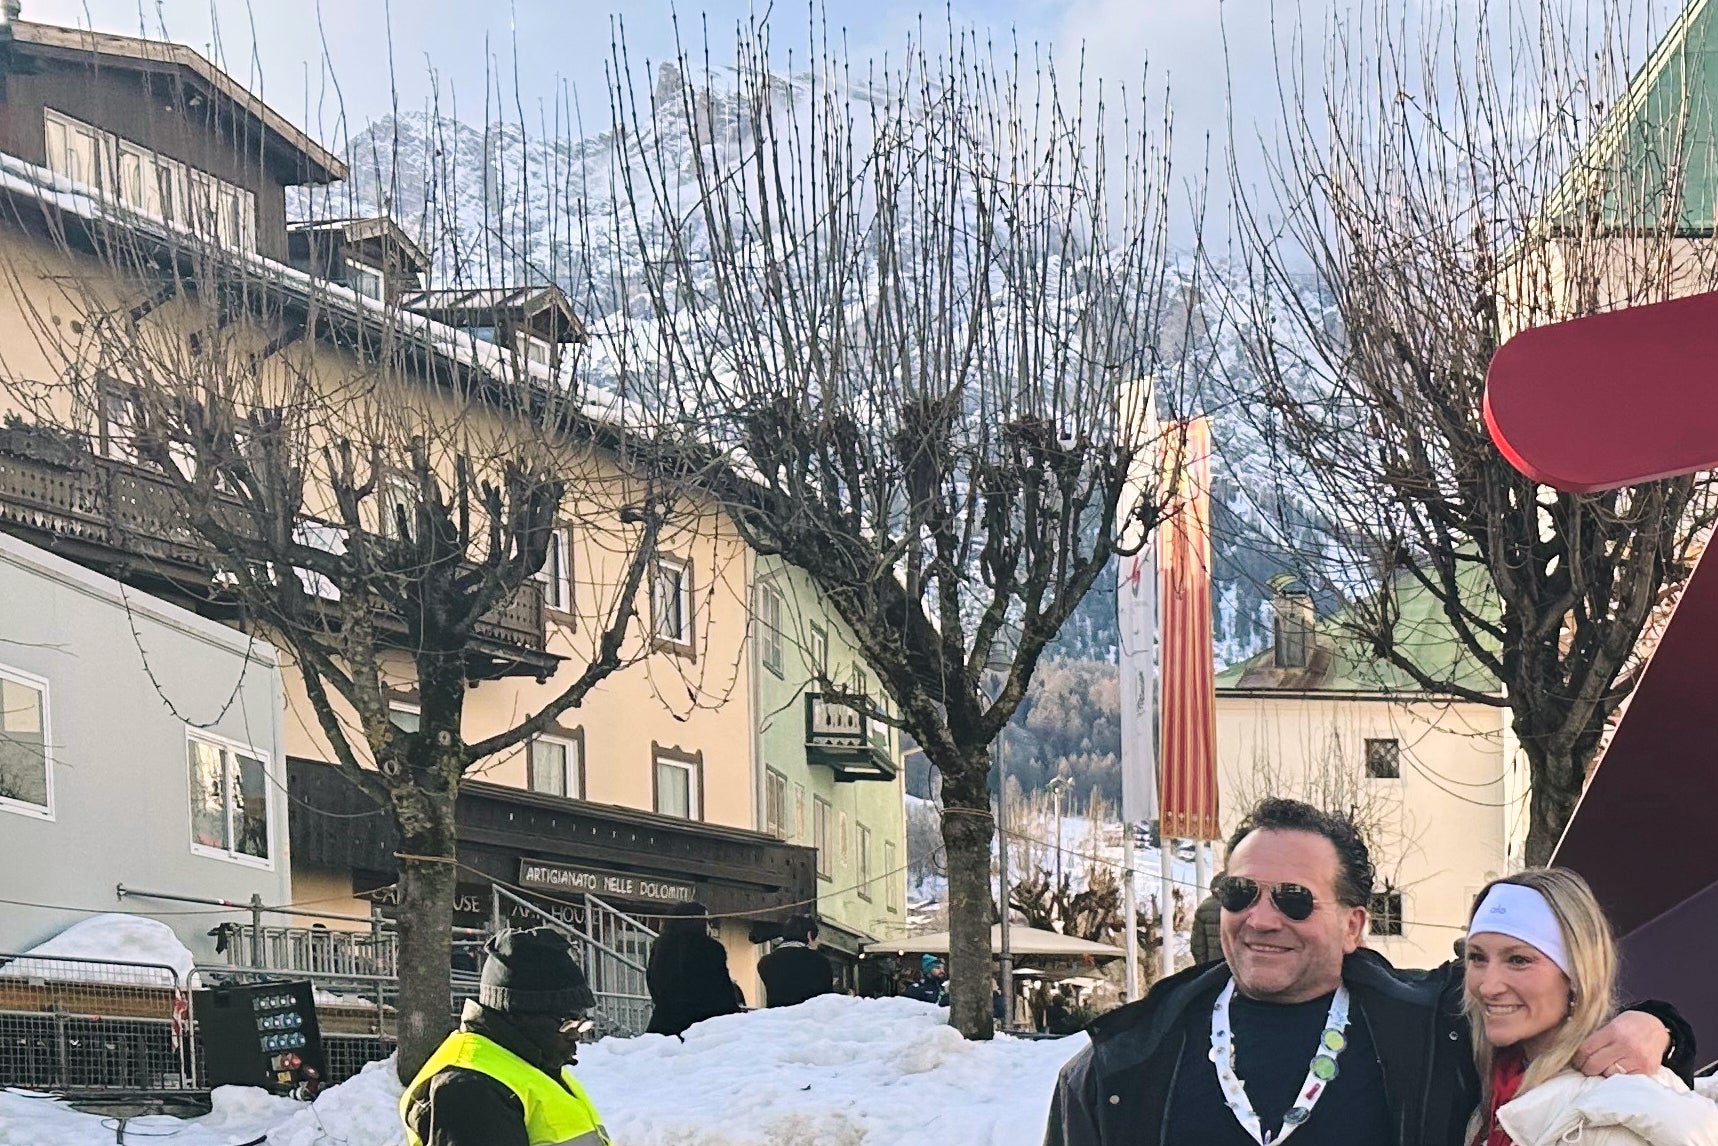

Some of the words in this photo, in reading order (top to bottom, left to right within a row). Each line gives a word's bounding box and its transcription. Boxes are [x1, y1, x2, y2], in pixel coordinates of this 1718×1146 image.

[525, 866, 598, 890] ARTIGIANATO
[603, 877, 633, 895] NELLE
[453, 895, 480, 913] USE
[551, 904, 599, 926] HOUE
